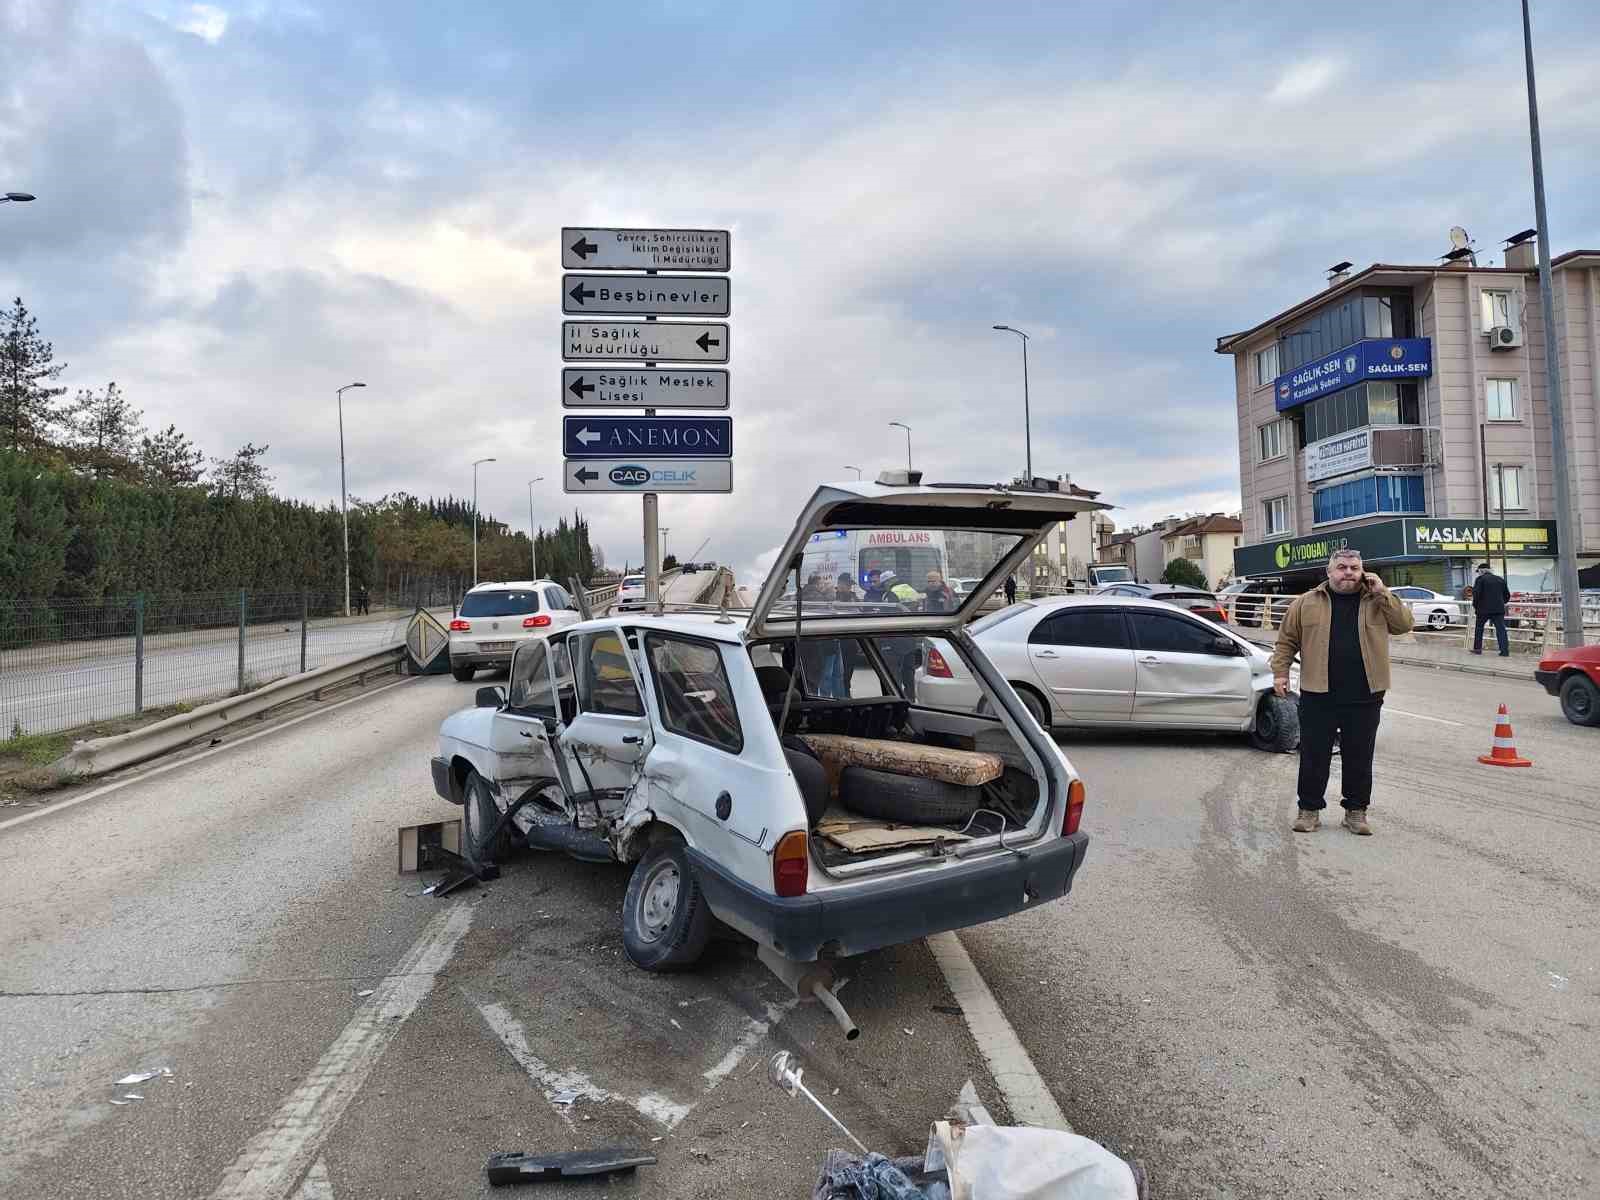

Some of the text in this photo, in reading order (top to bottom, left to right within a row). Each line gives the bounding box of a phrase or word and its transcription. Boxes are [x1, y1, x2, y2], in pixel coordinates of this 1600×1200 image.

[599, 288, 720, 303] Beşbinevler
[570, 327, 641, 341] İl Sağlık
[570, 343, 659, 357] Müdürlüğü
[1292, 358, 1341, 387] SAĞLIK-SEN
[1368, 363, 1428, 374] SAĞLIK-SEN
[599, 375, 714, 388] Sağlık Meslek
[599, 391, 644, 401] Lisesi
[609, 428, 721, 446] ANEMON
[868, 532, 929, 545] AMBULANS
[1415, 527, 1486, 543] MASLAK
